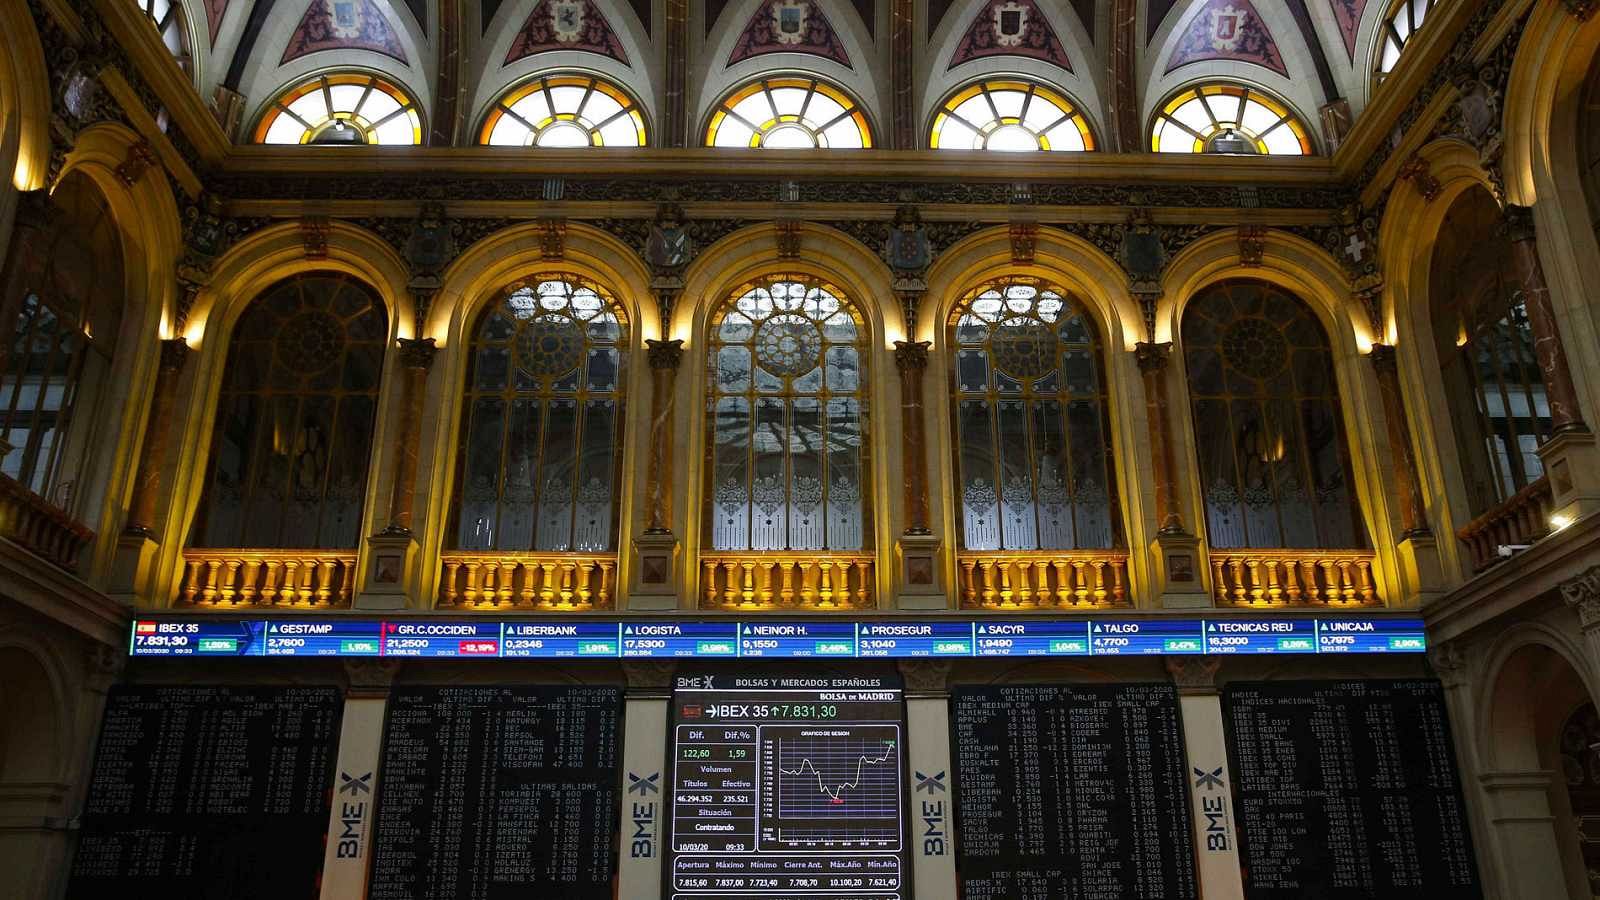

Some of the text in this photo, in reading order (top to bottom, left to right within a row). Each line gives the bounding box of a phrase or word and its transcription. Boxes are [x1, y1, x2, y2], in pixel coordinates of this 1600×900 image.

[159, 624, 199, 633] IBEX 35
[280, 624, 333, 634] GESTAMP
[399, 625, 476, 635] GR.C.OCCIDEN
[517, 626, 577, 635] LIBERBANK
[635, 626, 682, 635] LOGISTA
[754, 626, 808, 635] NEINOR H.
[872, 626, 931, 635] PROSEGUR
[989, 625, 1025, 634] SACYR
[1104, 624, 1139, 633] TALGO
[1218, 623, 1293, 632] TECNICAS REU
[1330, 622, 1374, 632] UNICAJA
[136, 636, 188, 646] 7.831,30
[268, 638, 305, 648] 2,7600
[387, 639, 429, 648] 21,2500
[505, 640, 543, 649] 0,2348
[624, 640, 665, 649] 17,5300
[743, 640, 778, 649] 9,1550
[861, 640, 896, 649] 3,1040
[978, 639, 1012, 648] 1,9490
[1094, 638, 1128, 647] 4,7700
[1208, 637, 1248, 646] 16,3000
[1320, 636, 1354, 645] 0,7975
[677, 677, 881, 687] BME BOLSAS Y MERCADOS ESPAÑOLES
[820, 693, 847, 701] BOLSA
[858, 693, 894, 701] MADRID
[717, 705, 837, 718] IBEX 35 7.831,30
[689, 731, 750, 739] Dif. Dif.%
[683, 750, 746, 760] 122,60 1,59
[700, 766, 732, 774] Volumen
[683, 780, 751, 788] Títulos Efectivo
[677, 795, 749, 803] 46.294.352 235.521
[698, 808, 732, 817] Situación
[695, 824, 735, 832] Contratando
[922, 800, 944, 856] BME
[1203, 796, 1227, 851] BME
[337, 802, 363, 858] BME
[631, 802, 653, 858] BME
[679, 843, 744, 851] 10/03/20 09:33
[677, 860, 897, 870] Apertura Máximo Mínimo Cierre Ant. Máx.Año Mín.Año
[679, 879, 897, 888] 7.815,60 7.837,00 7.723,40 7.708,70 10.100,20 7.621,40
